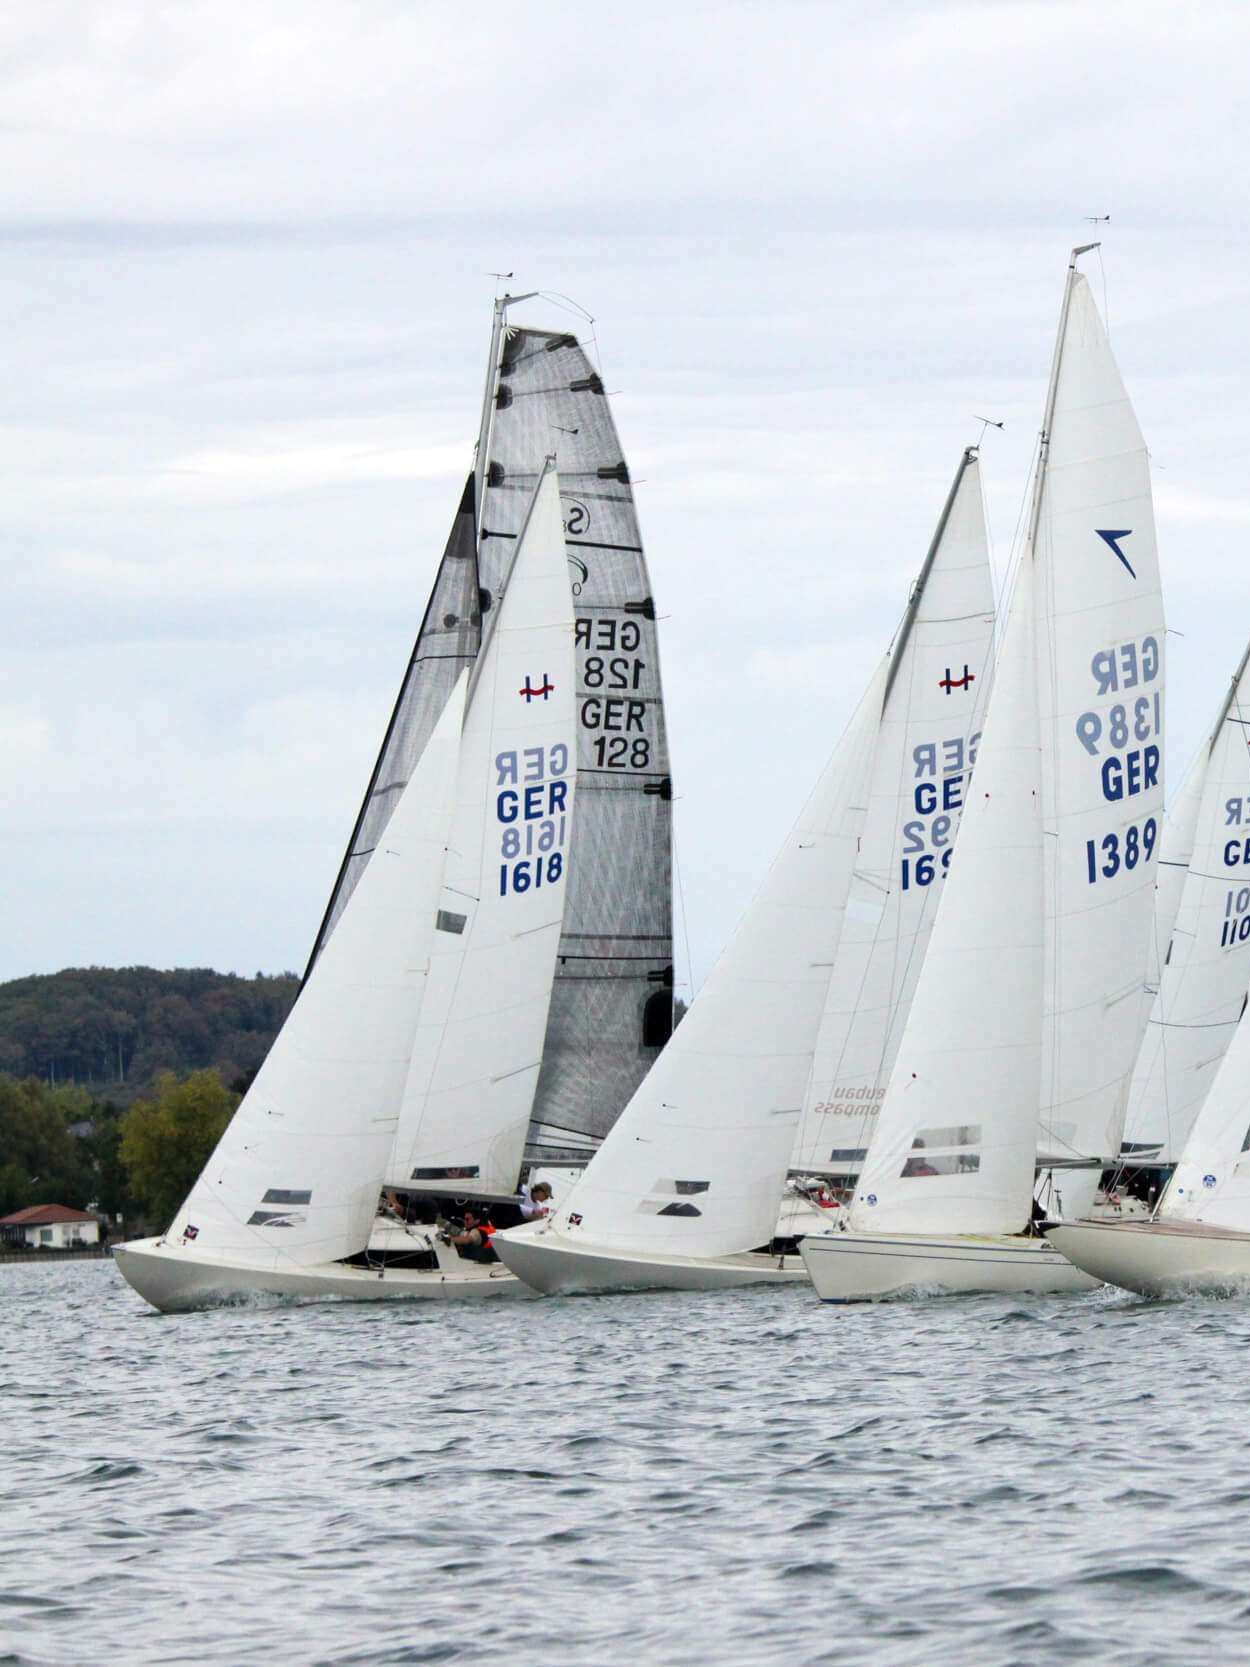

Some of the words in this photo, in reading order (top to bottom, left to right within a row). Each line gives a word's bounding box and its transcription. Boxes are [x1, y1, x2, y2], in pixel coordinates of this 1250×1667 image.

[581, 699, 646, 732] GER
[594, 735, 649, 769] 128
[1101, 744, 1159, 802] GER
[497, 780, 566, 823] GER
[914, 773, 972, 815] GE
[1086, 818, 1156, 884] 1389
[500, 852, 563, 896] 1618
